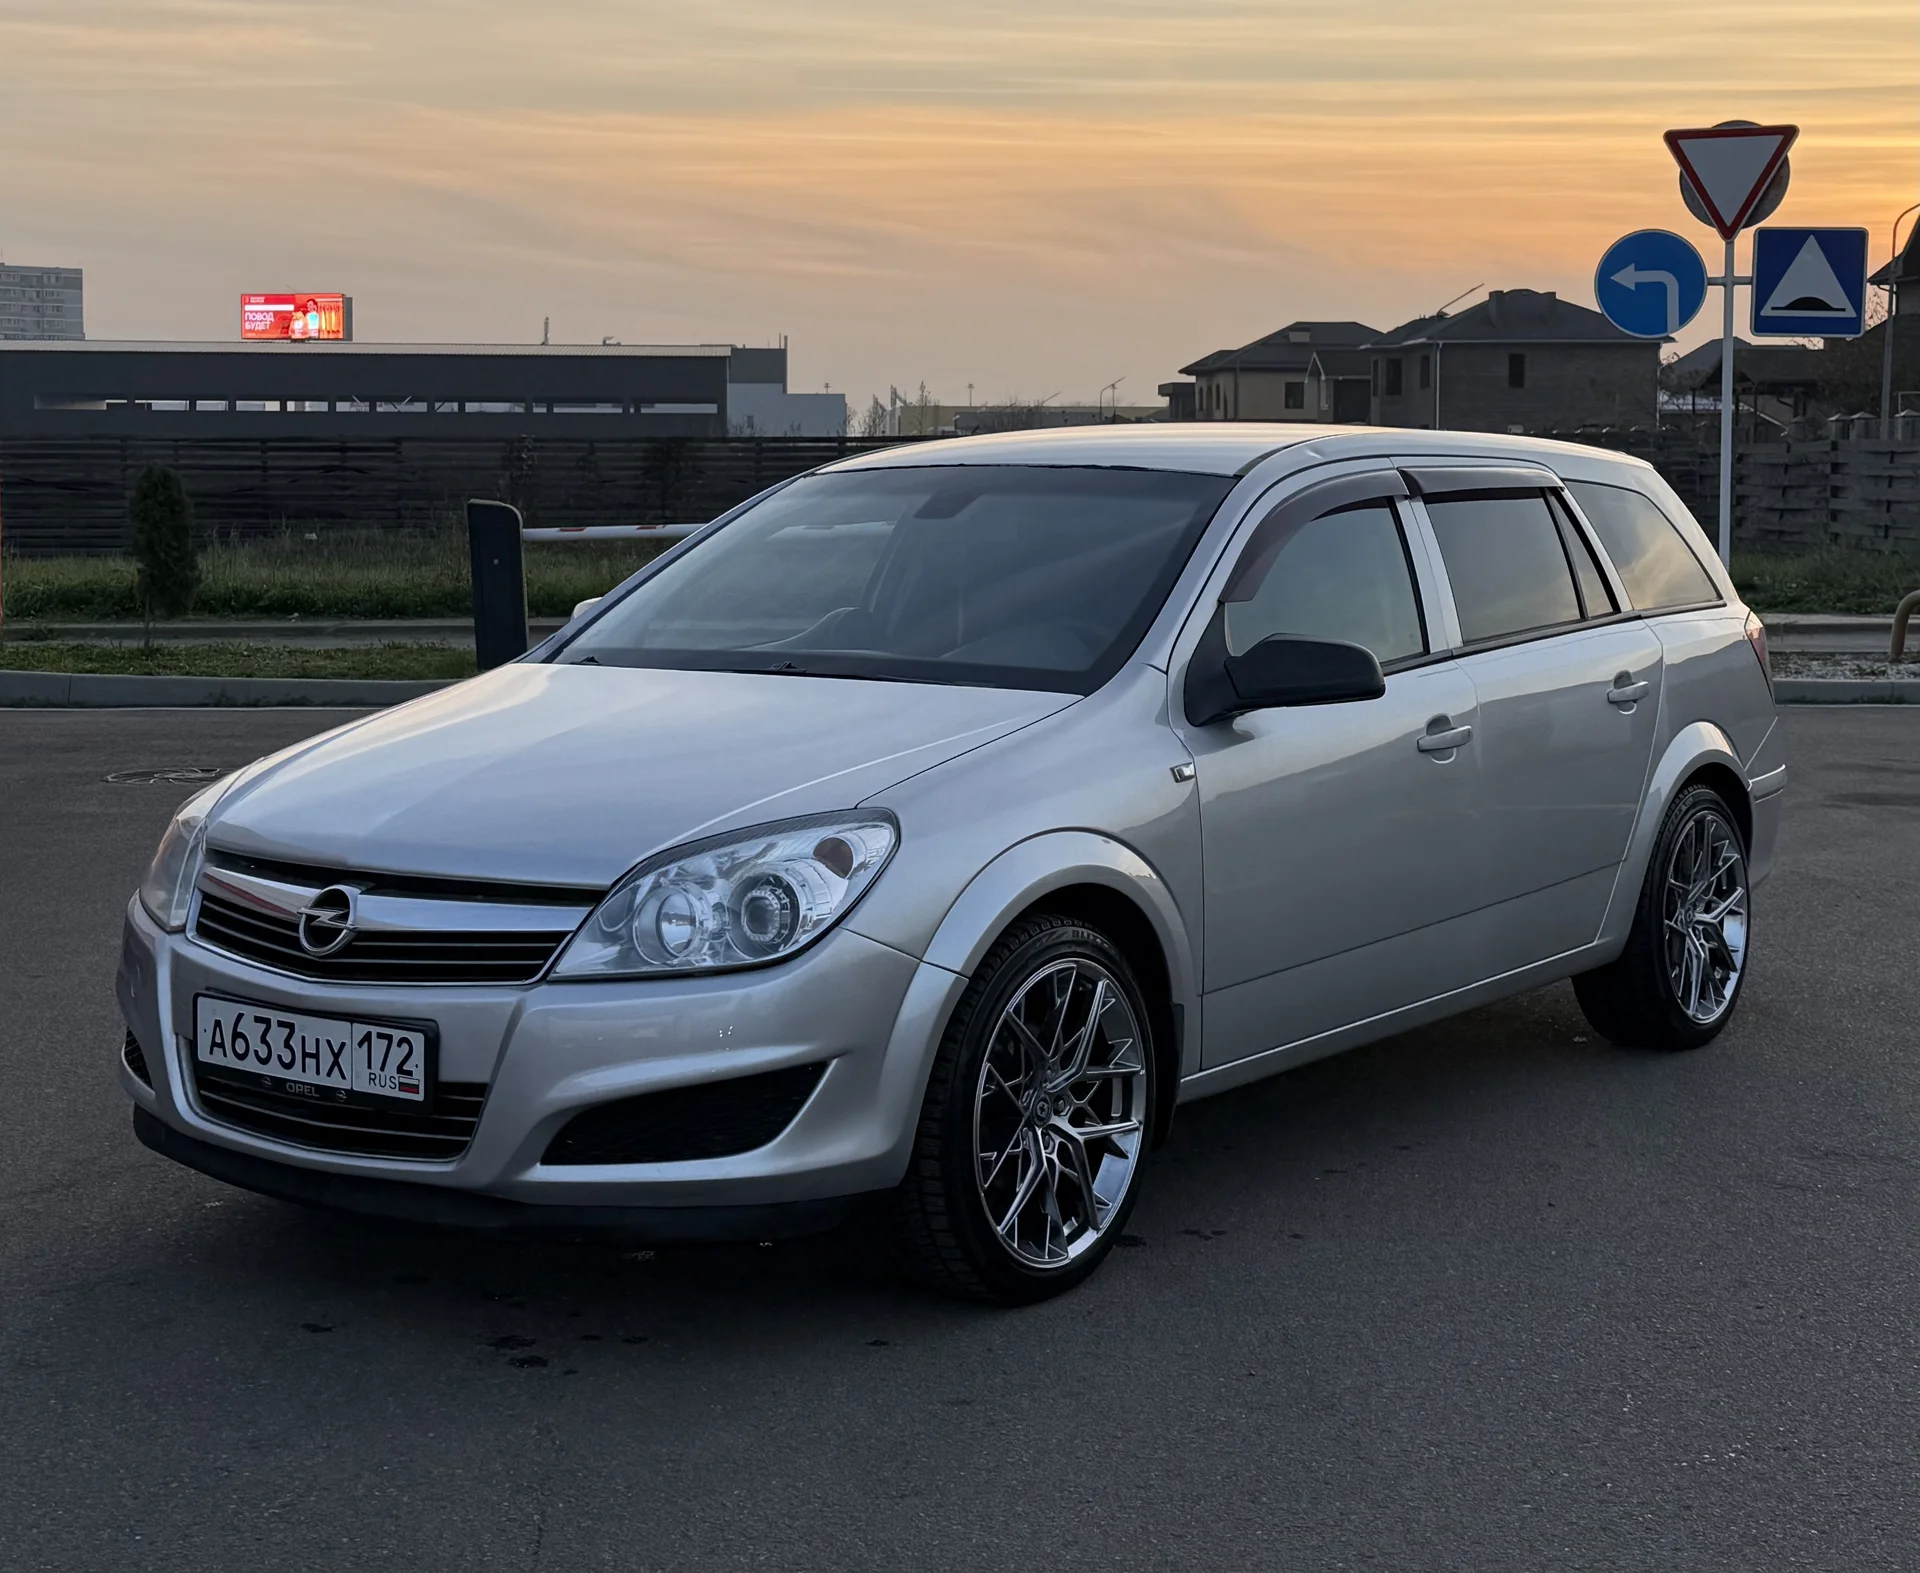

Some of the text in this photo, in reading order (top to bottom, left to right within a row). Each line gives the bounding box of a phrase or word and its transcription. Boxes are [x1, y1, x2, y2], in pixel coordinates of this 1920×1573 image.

[245, 312, 274, 322] ПОВОД
[245, 321, 271, 331] БУДЕТ
[208, 1012, 414, 1081] А633НХ 172
[285, 1081, 320, 1098] OPEL
[368, 1072, 397, 1090] RUS
